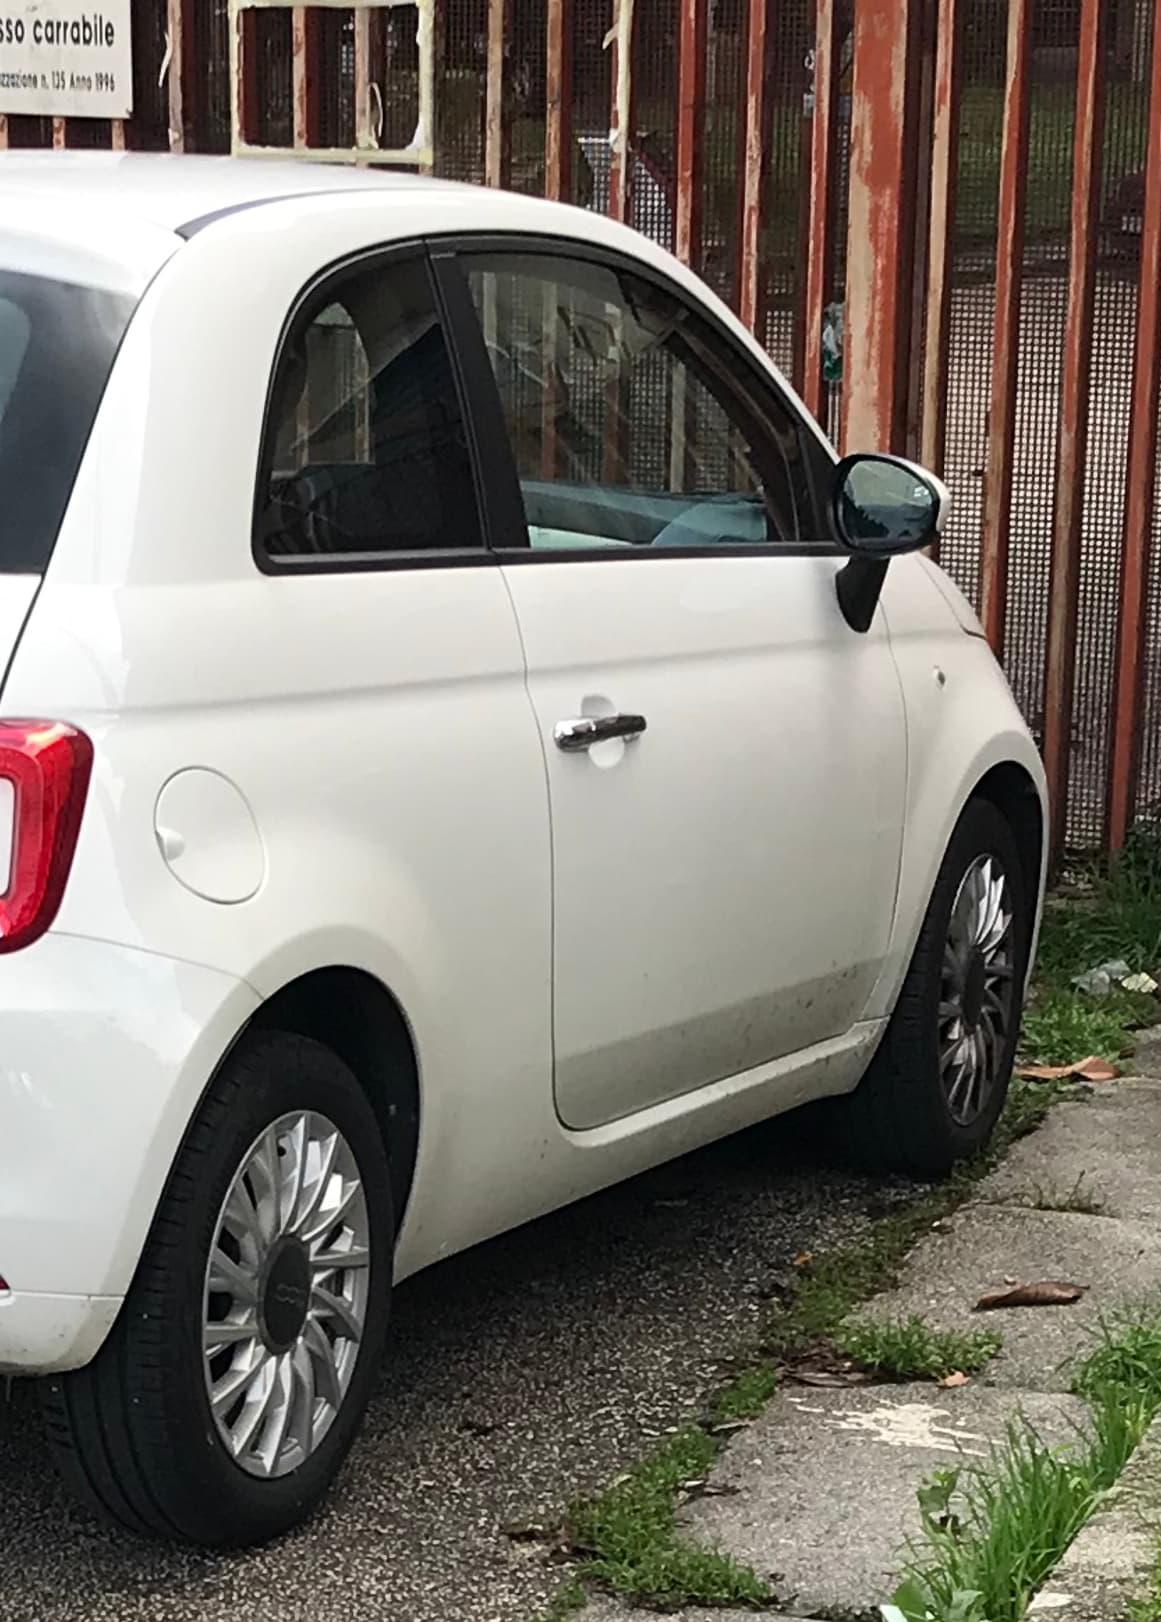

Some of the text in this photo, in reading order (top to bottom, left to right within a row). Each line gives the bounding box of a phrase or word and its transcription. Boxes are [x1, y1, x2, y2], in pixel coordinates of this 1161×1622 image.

[32, 14, 115, 47] carrabile
[69, 71, 92, 92] Anno
[95, 72, 115, 93] 1996
